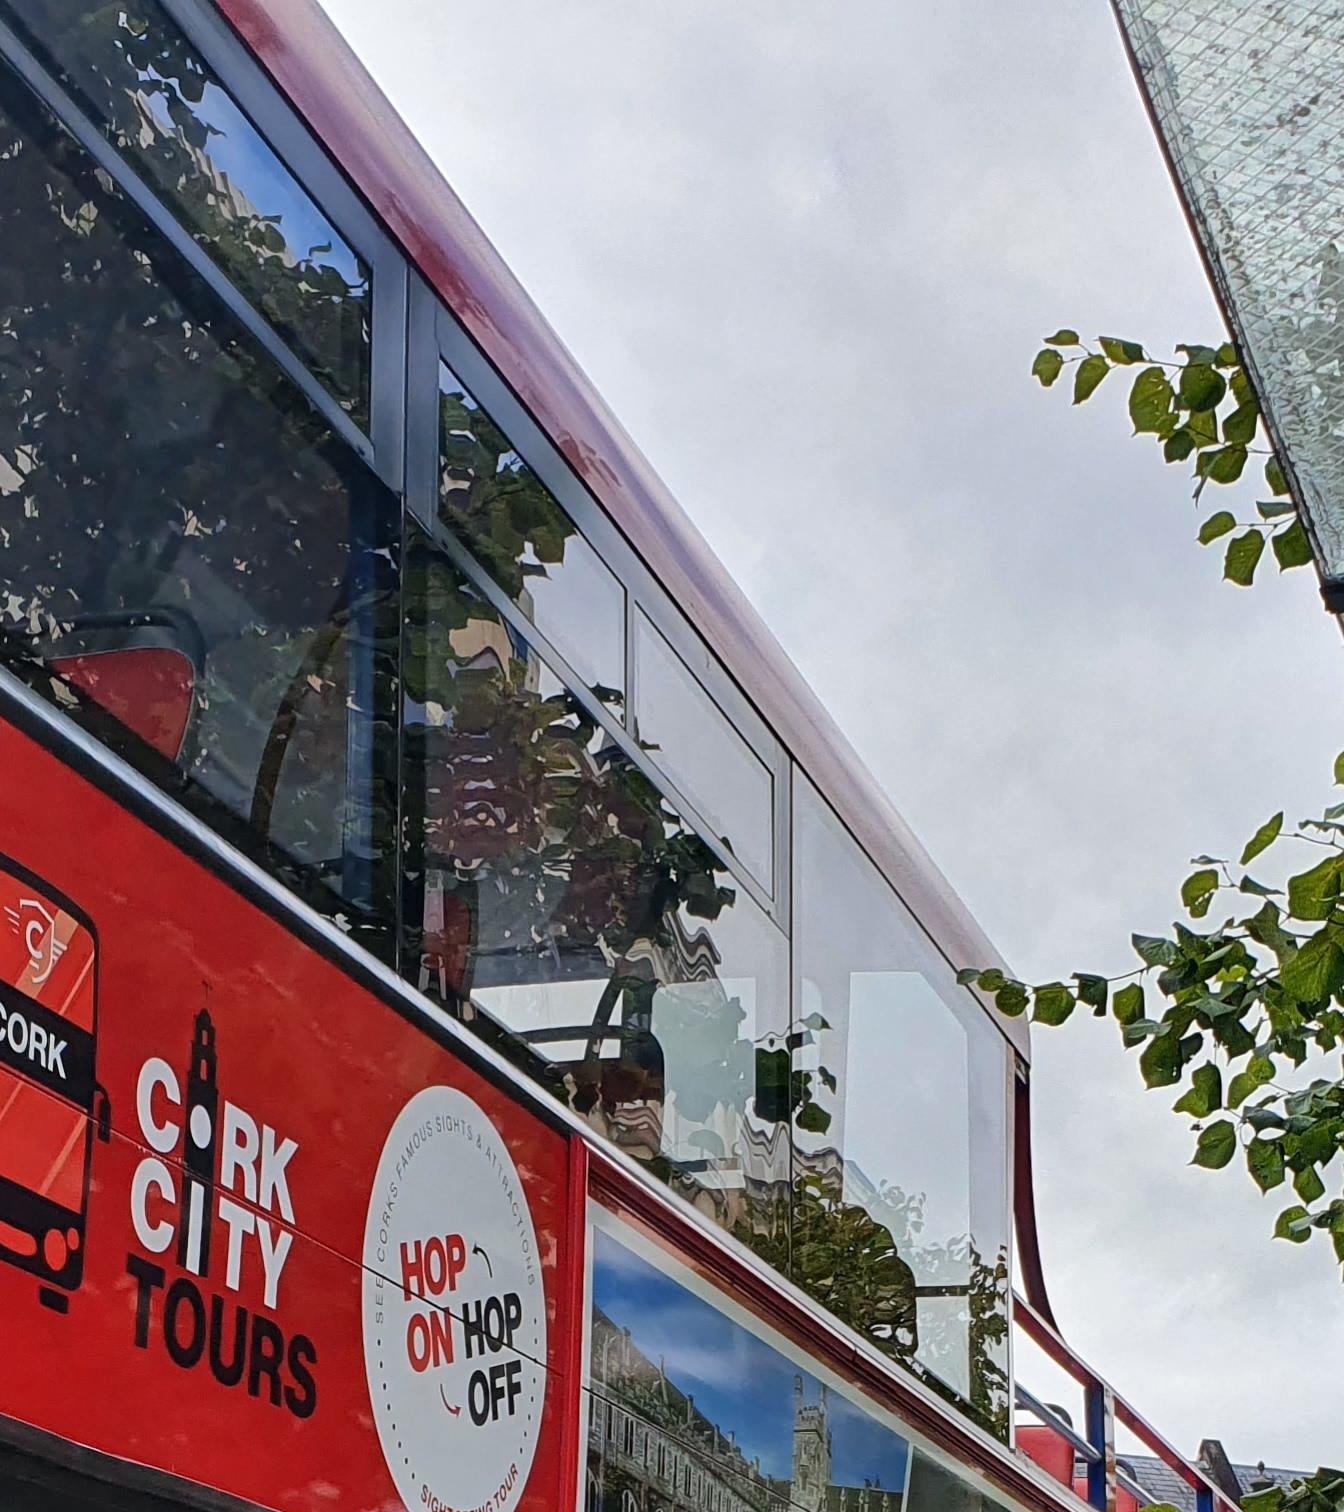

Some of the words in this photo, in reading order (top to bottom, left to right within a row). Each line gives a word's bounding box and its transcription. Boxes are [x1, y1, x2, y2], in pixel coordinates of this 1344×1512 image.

[136, 1057, 299, 1225] CORK
[396, 1121, 433, 1181] FAMOUS
[436, 1115, 473, 1141] SIGHTS
[131, 1157, 293, 1309] CITY
[377, 1182, 399, 1262] CORKS
[485, 1147, 536, 1286] ATTRACTIONS
[375, 1277, 384, 1324] SEE
[400, 1233, 466, 1302] HOP
[126, 1252, 317, 1420] TOURS
[407, 1306, 454, 1373] ON
[462, 1292, 522, 1359] HOP
[468, 1359, 522, 1427] OFF
[493, 1463, 519, 1509] TOUR
